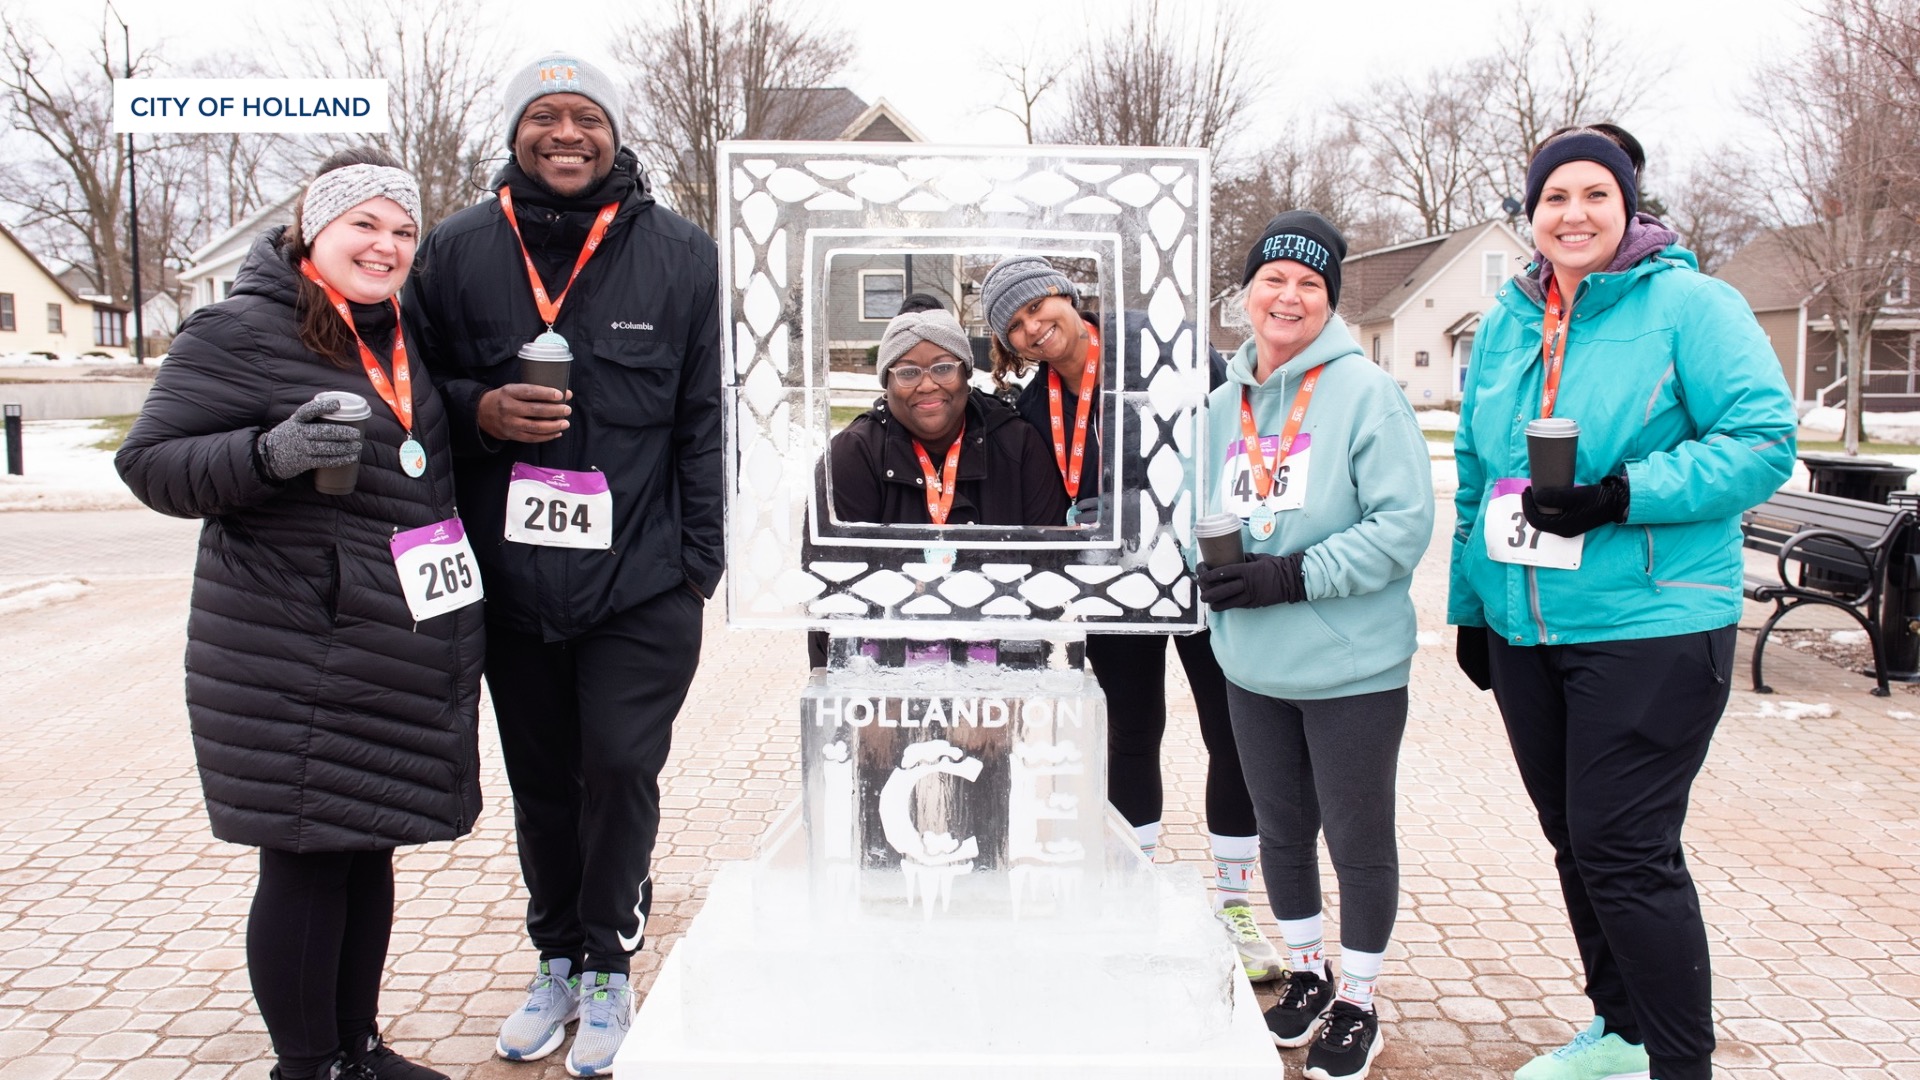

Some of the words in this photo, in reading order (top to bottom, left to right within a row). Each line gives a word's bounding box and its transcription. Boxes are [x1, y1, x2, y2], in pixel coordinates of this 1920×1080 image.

[1262, 234, 1330, 265] DETROIT
[1265, 249, 1324, 271] FOOTBALL
[618, 321, 653, 331] Columbia
[1234, 465, 1290, 502] 46
[524, 496, 592, 534] 264
[418, 552, 473, 601] 265
[815, 696, 1010, 728] HOLLAND
[1021, 697, 1084, 728] ON
[822, 740, 1086, 866] ICE
